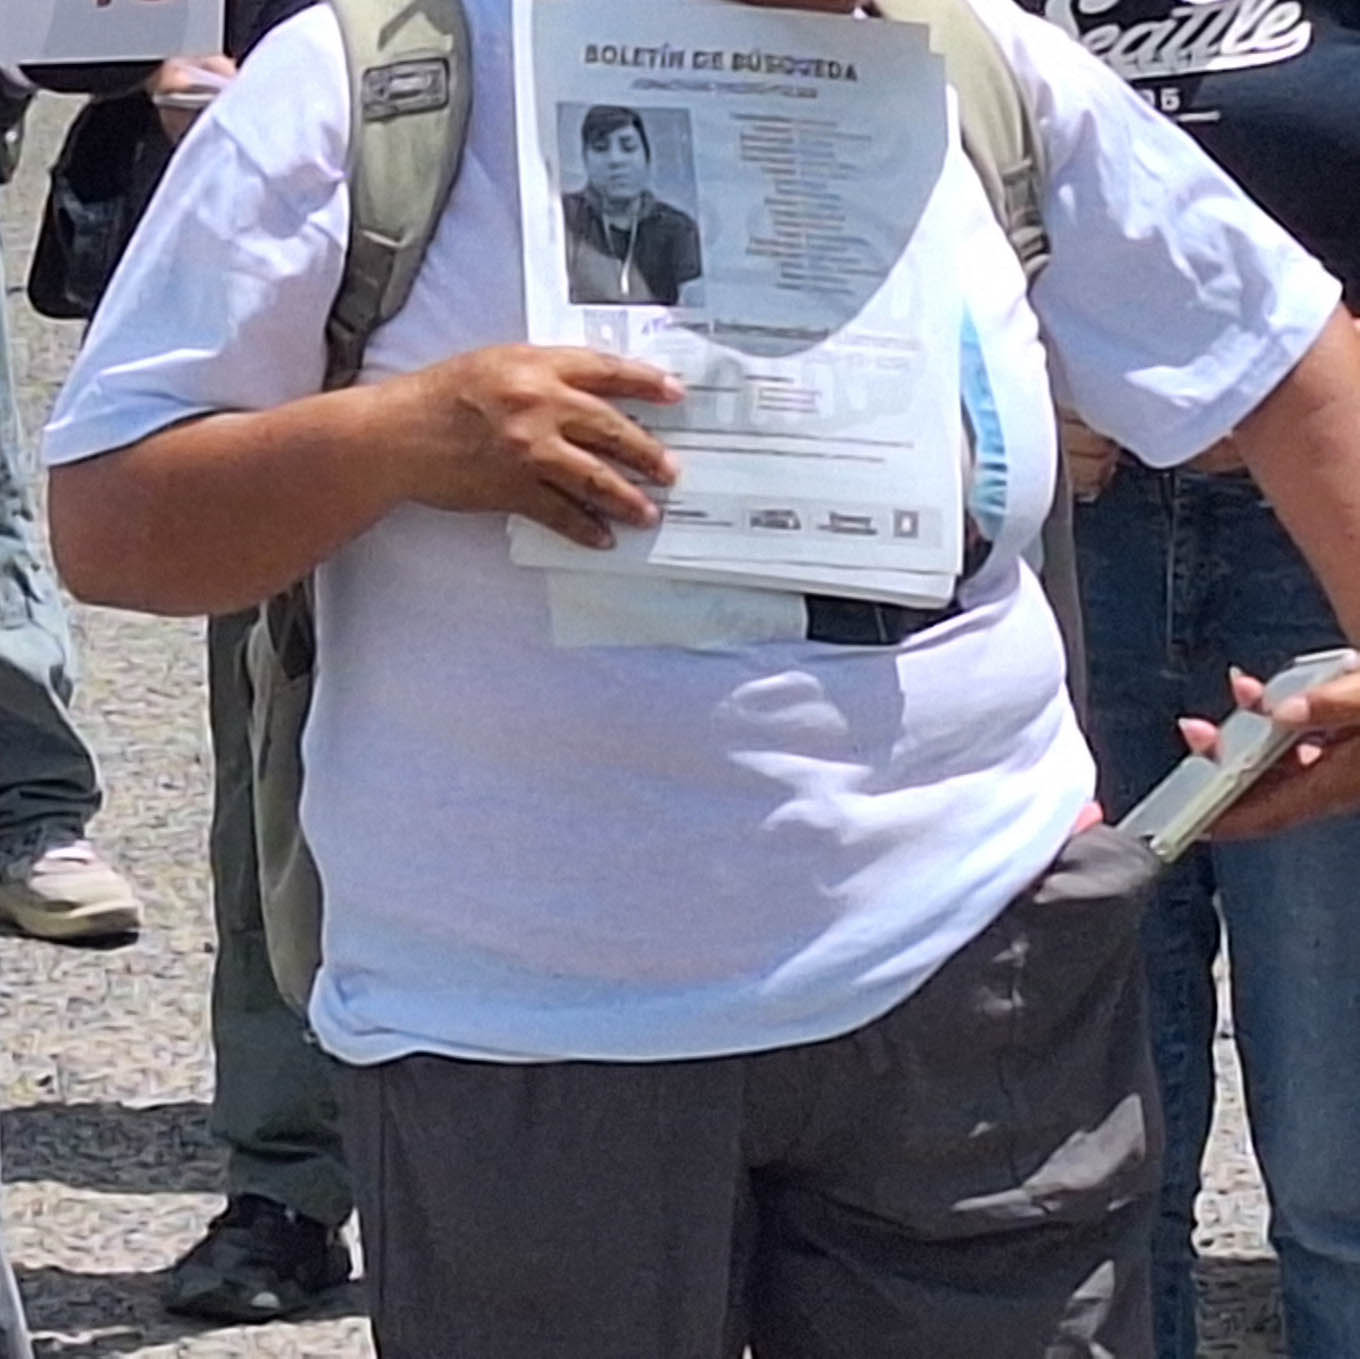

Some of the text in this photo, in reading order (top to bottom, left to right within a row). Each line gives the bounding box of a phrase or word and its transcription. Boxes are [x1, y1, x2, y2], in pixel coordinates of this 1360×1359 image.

[584, 42, 859, 82] BOLETÍN DE BÚSQUEDA
